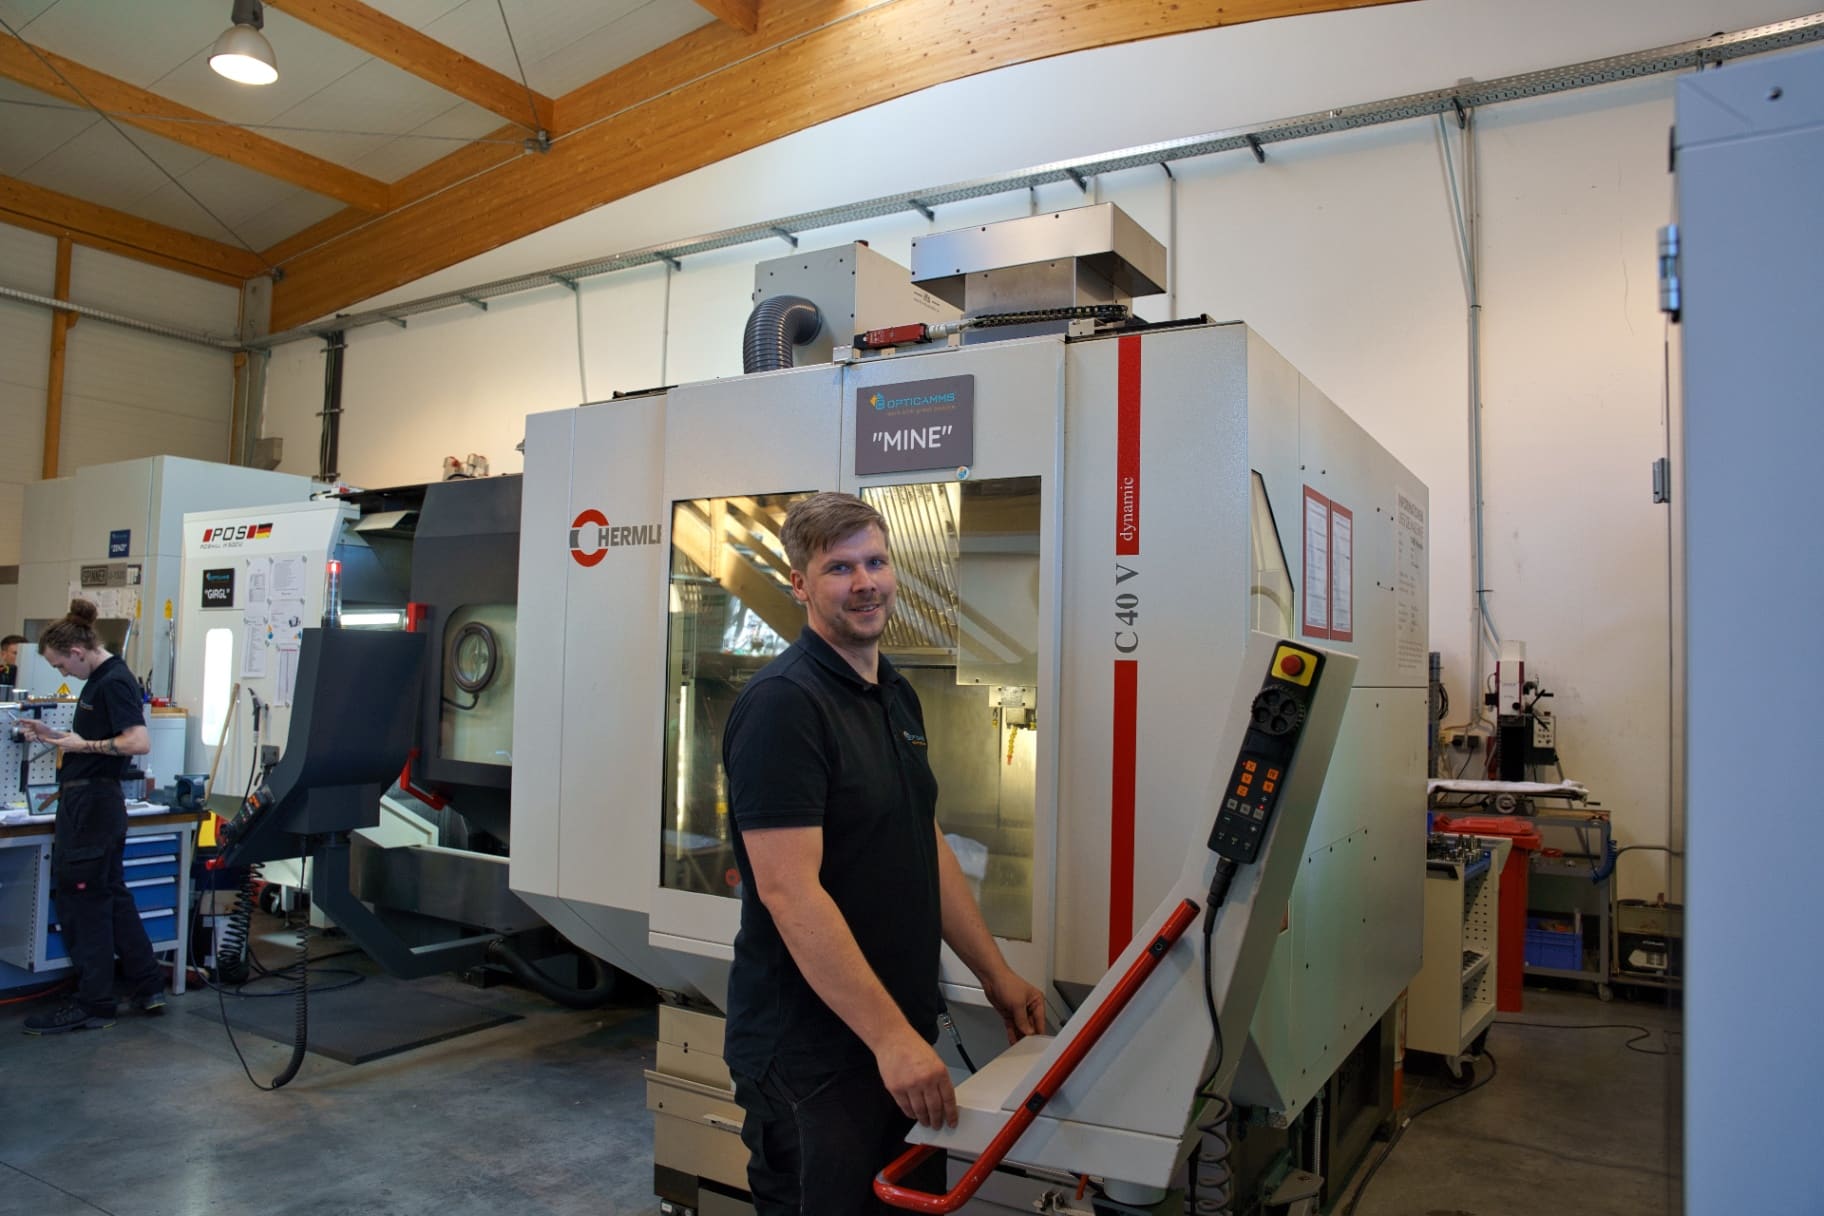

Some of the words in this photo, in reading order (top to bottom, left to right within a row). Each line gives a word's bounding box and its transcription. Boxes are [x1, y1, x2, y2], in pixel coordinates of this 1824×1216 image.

[887, 392, 956, 409] OPTICAMMS
[873, 425, 953, 452] "MINE"
[1119, 476, 1137, 541] dynamic
[211, 525, 248, 542] POS
[1115, 562, 1139, 586] V
[1114, 593, 1139, 626] 40
[1114, 631, 1139, 654] C
